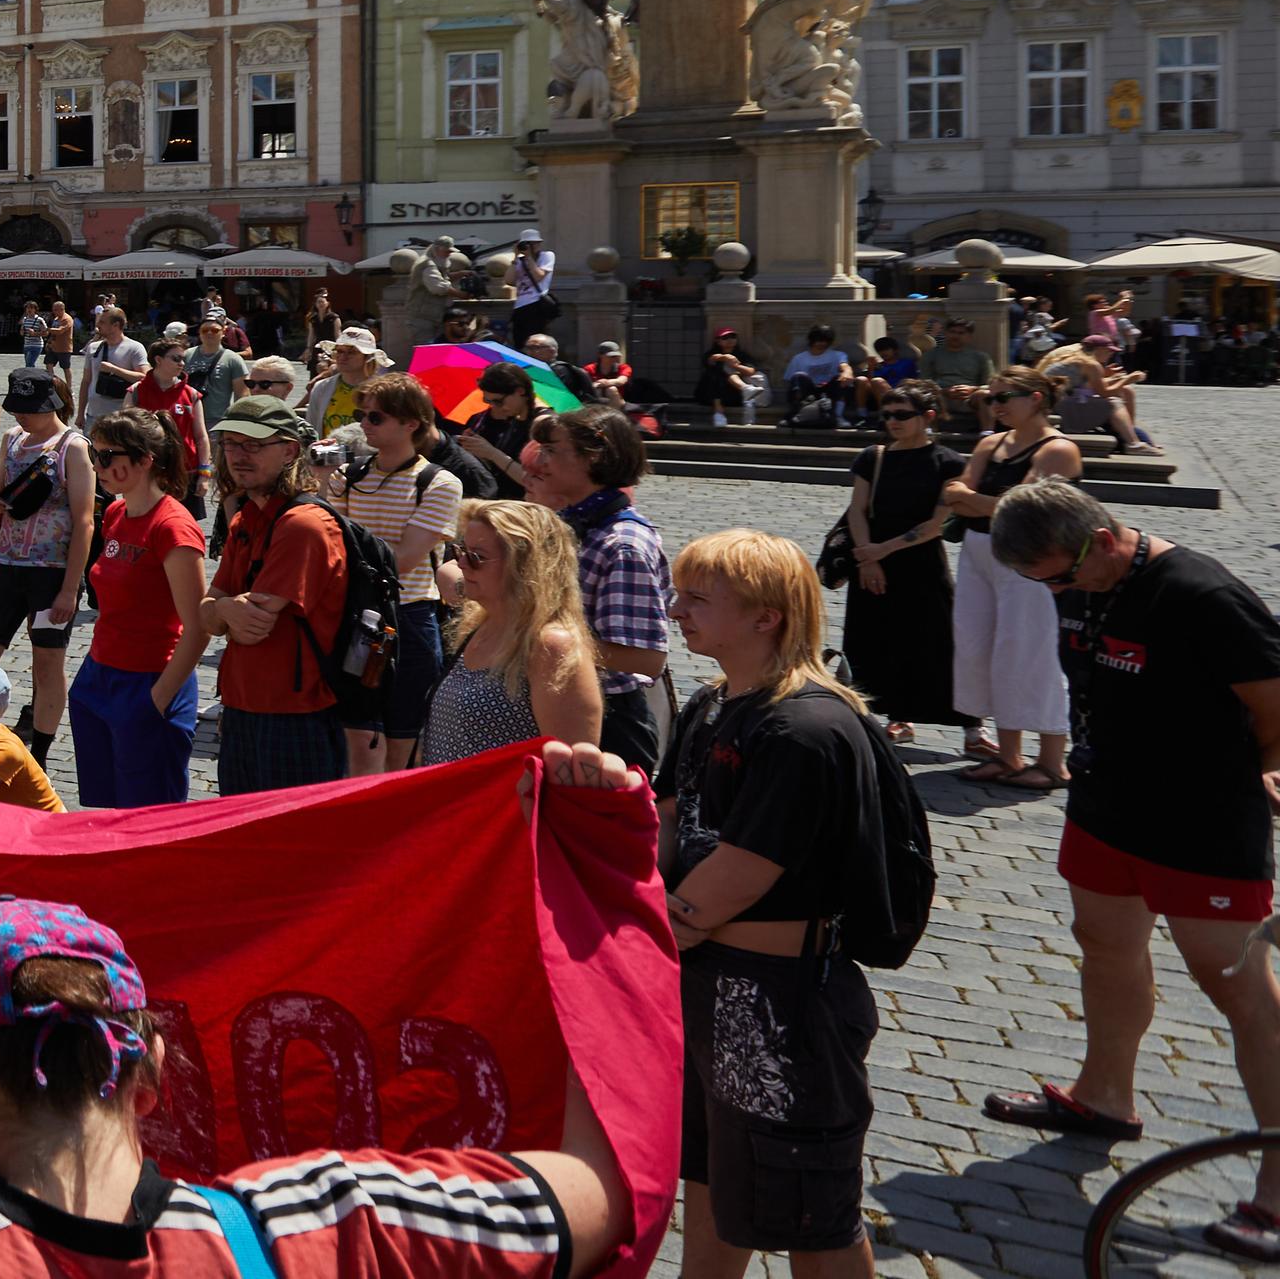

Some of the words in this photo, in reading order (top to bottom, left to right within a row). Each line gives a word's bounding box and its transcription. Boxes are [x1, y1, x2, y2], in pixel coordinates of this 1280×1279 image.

[101, 271, 119, 279] PIZZA
[126, 270, 145, 278] PASTA
[152, 270, 178, 278] RISOTTO
[223, 268, 245, 276] STEAKS
